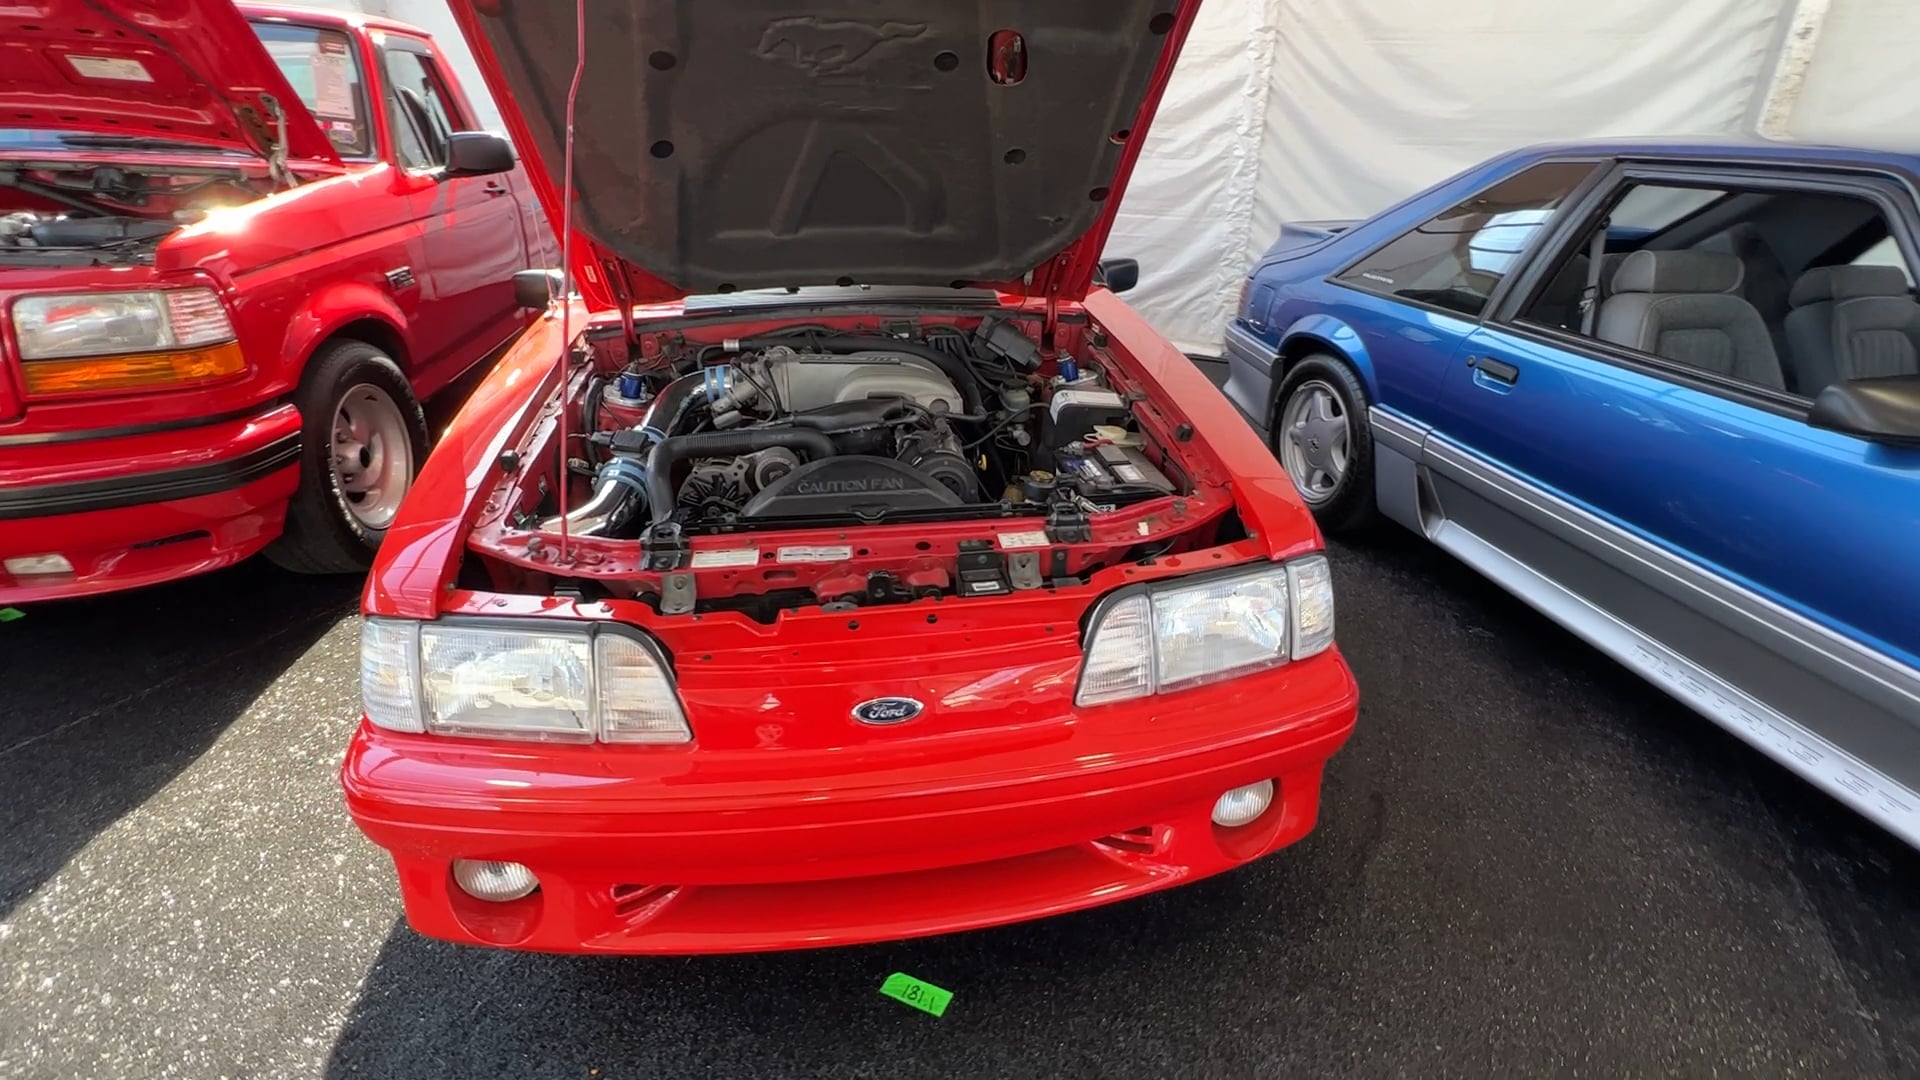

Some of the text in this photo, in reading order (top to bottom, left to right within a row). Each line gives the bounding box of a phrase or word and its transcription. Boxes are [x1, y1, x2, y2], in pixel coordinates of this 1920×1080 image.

[797, 478, 904, 493] CAUTION FAN
[868, 702, 907, 719] Ford
